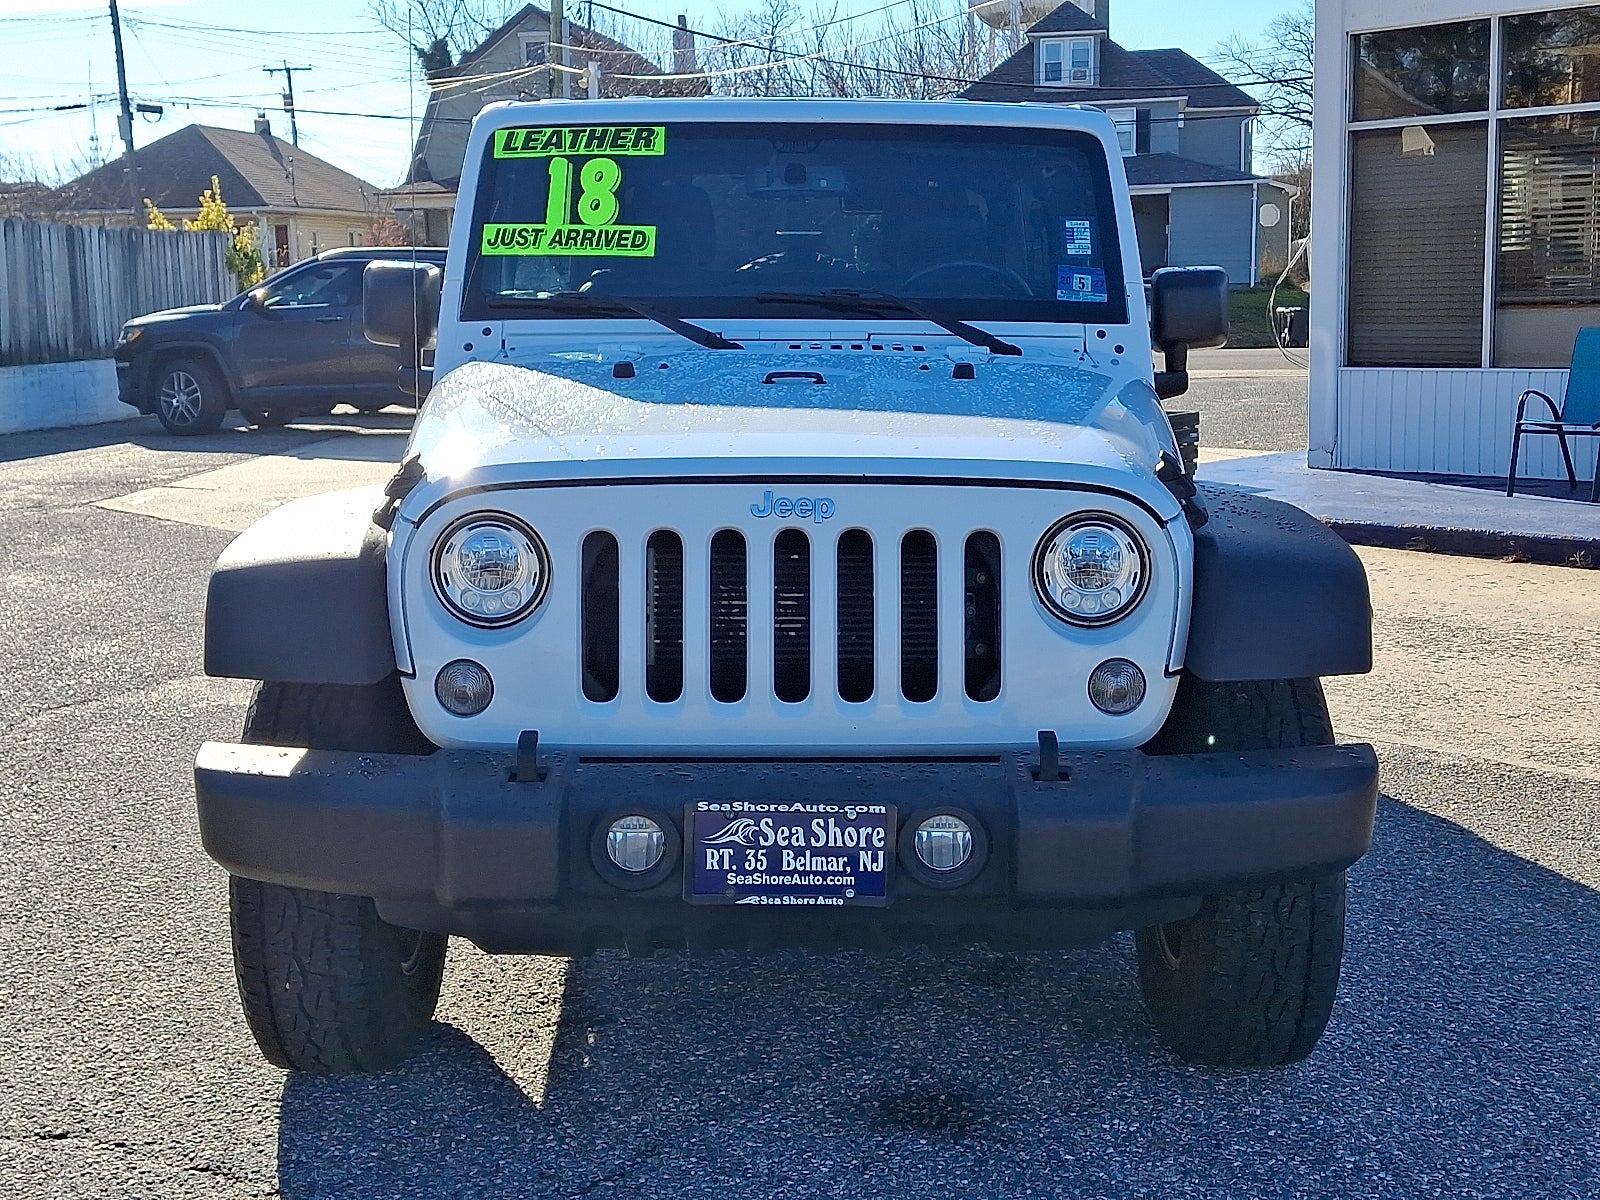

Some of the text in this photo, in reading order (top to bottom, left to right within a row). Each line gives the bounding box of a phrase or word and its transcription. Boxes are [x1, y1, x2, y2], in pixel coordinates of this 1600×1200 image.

[502, 127, 659, 154] LEATHER
[546, 156, 622, 225] 18
[486, 227, 650, 251] JUST ARRIVED
[1078, 277, 1086, 290] 5
[750, 490, 836, 524] Jeep
[697, 801, 887, 814] SeaShoreAuto.com
[758, 817, 886, 848] Sea Shore
[705, 848, 885, 874] RT. 35 Belmar, NJ
[726, 872, 855, 886] SeaShoreAuto.com
[760, 896, 844, 906] Sea Shore Auto
